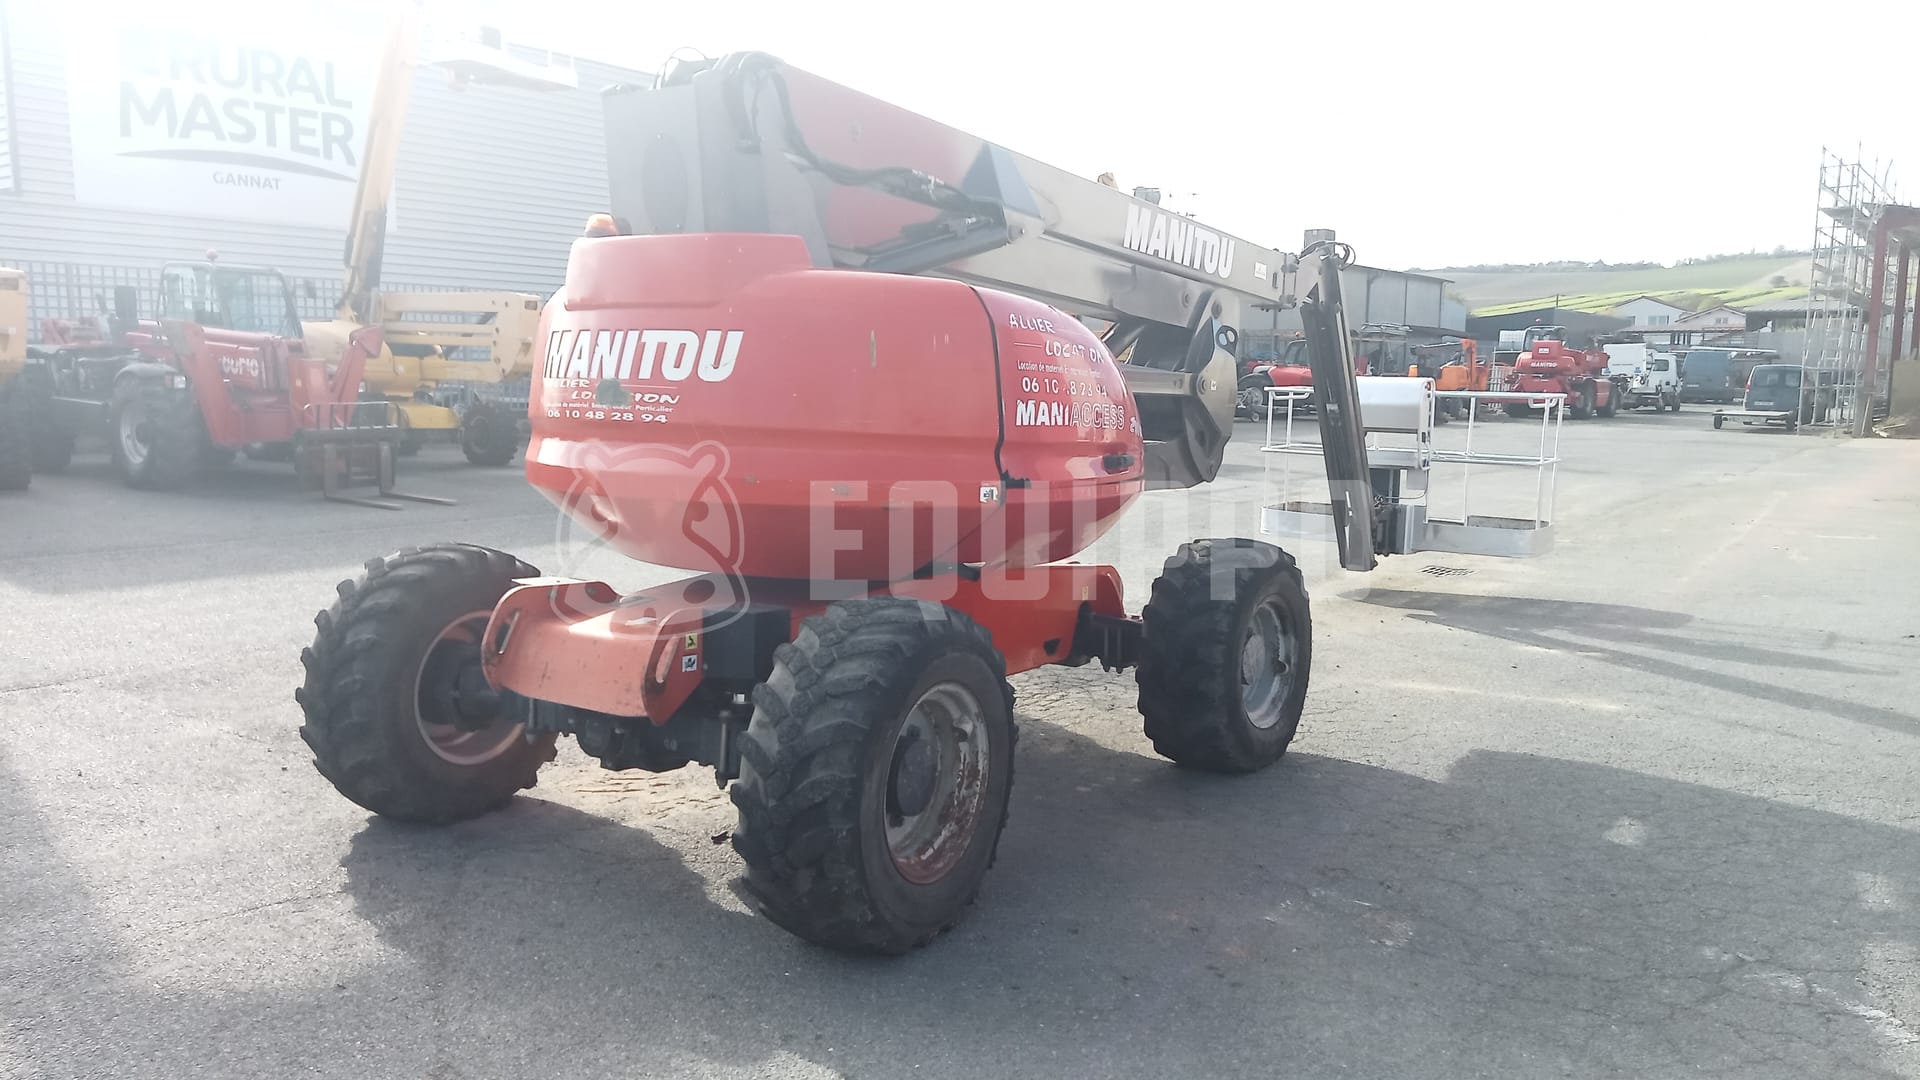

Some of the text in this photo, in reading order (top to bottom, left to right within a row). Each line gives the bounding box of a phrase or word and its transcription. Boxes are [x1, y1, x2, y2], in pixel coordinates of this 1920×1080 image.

[119, 81, 357, 167] MASTER
[212, 171, 282, 190] GANNAT
[1123, 203, 1235, 279] MANITOU
[1009, 313, 1056, 334] ALLIER
[544, 329, 744, 382] MANITOU
[1022, 377, 1039, 393] 06
[572, 390, 680, 404] LOION
[547, 409, 668, 423] 06 10 48 28 94
